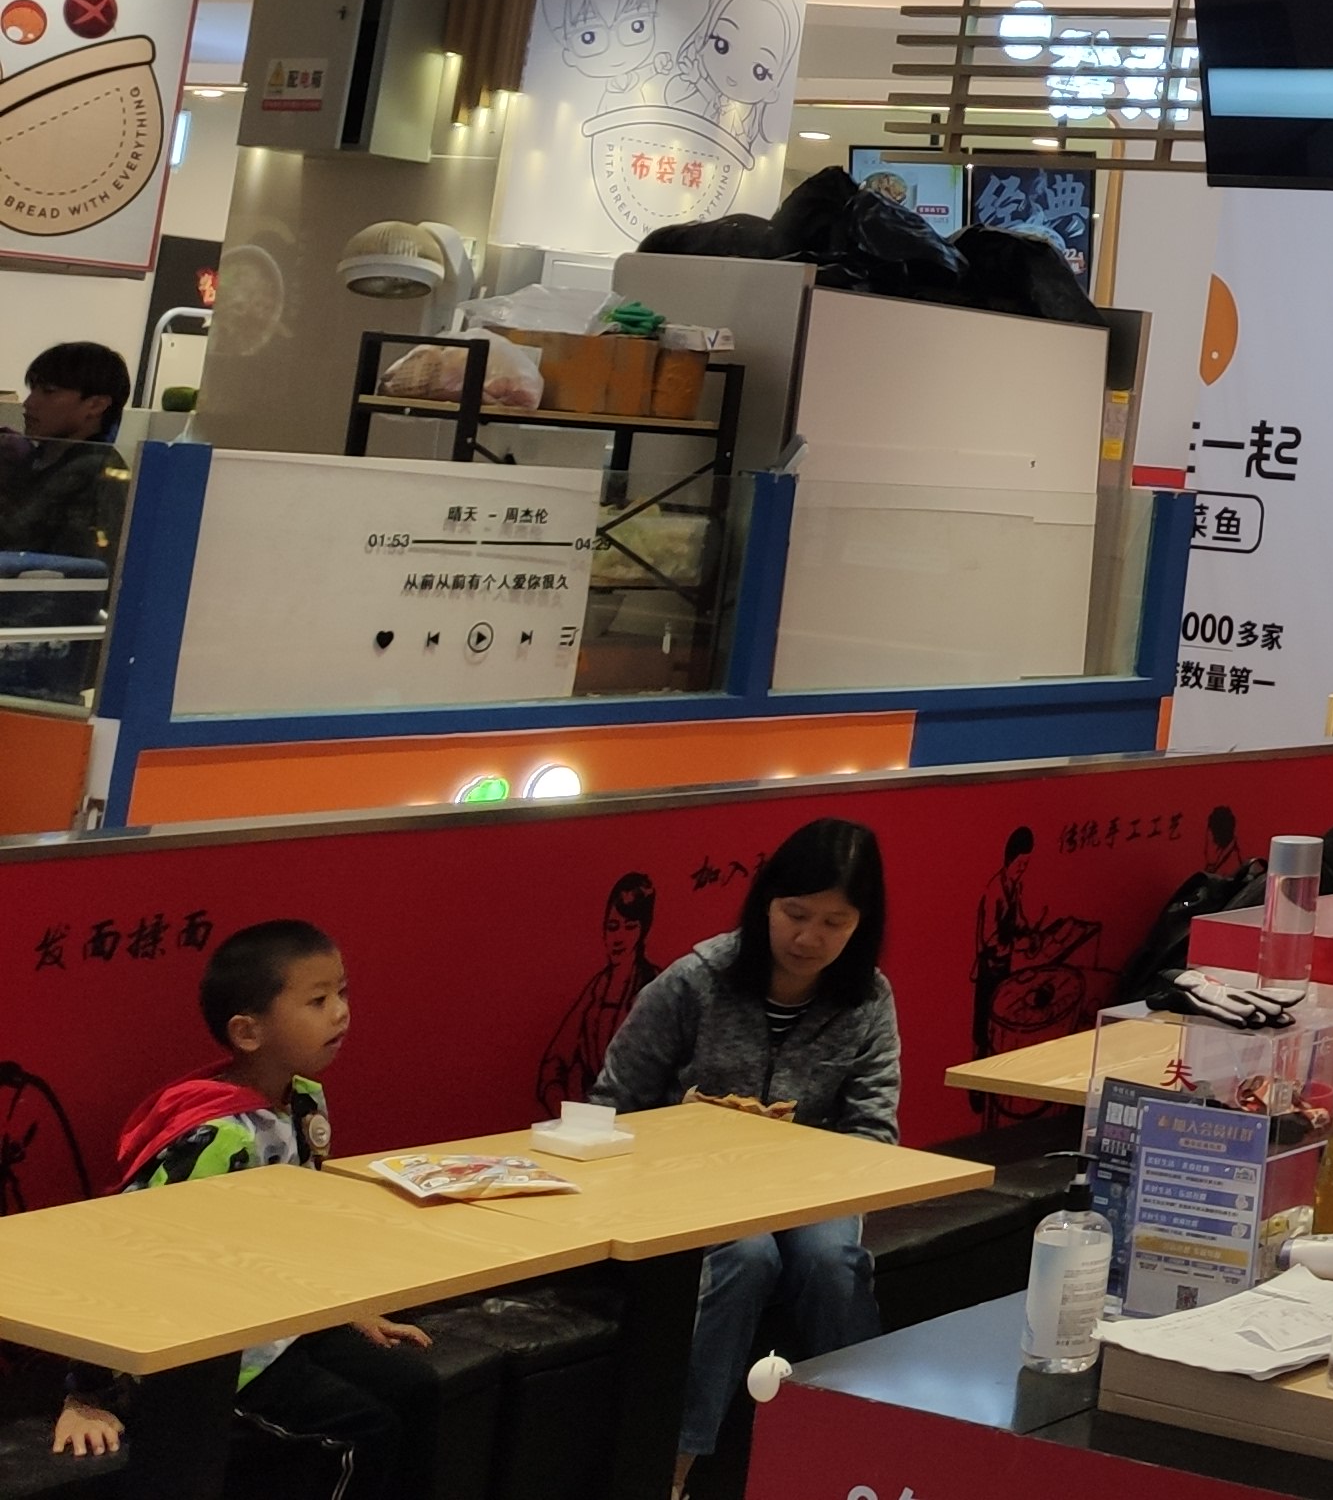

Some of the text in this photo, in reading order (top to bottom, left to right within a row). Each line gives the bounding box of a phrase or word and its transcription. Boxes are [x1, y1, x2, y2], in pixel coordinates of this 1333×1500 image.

[4, 86, 148, 219] BREAD WITH EVERYTHING
[631, 151, 704, 190] 布袋馍
[604, 143, 639, 226] PITA BREAD
[1187, 419, 1303, 482] 一起
[447, 506, 478, 523] 晴天
[502, 507, 549, 525] 周杰伦
[367, 533, 612, 551] 01:53 04:29
[403, 572, 569, 592] 从前从前有个人爱你很久
[1180, 660, 1276, 696] 数量第一
[33, 908, 215, 972] 发面揉面
